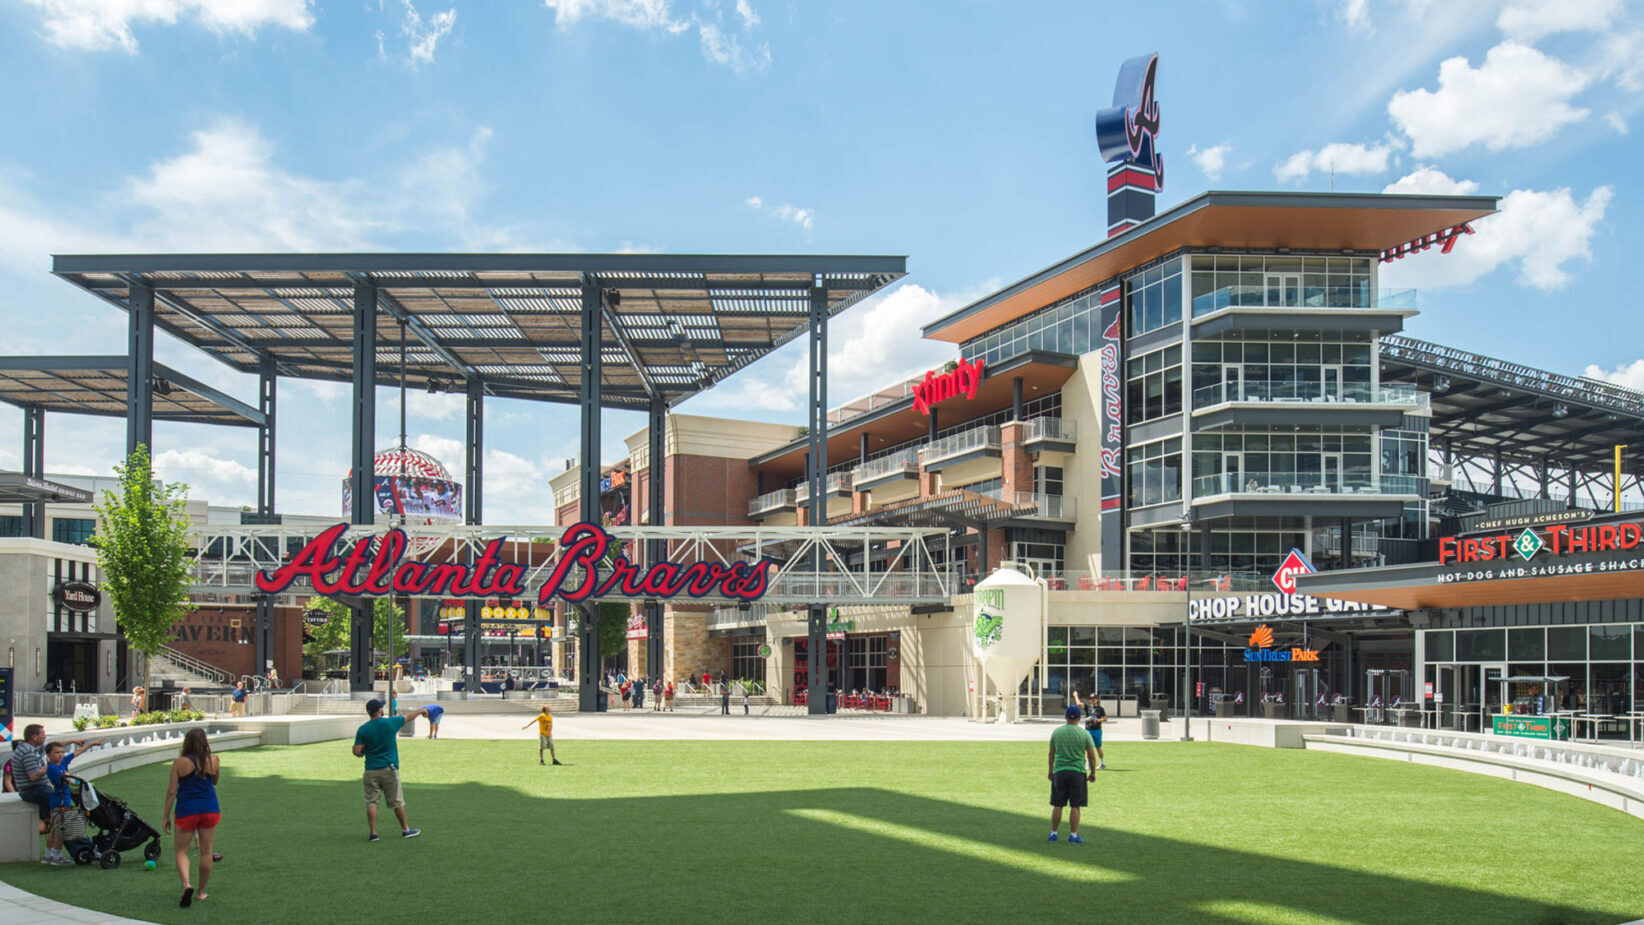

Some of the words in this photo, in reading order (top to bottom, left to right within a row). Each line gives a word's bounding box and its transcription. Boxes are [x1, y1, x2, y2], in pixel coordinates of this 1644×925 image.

[911, 357, 984, 416] xfinity
[1480, 520, 1502, 529] CHEF
[1506, 517, 1530, 526] HUGH
[1534, 511, 1586, 523] ACHESON'S
[1439, 535, 1512, 565] FIRST
[1520, 534, 1535, 553] &
[1545, 523, 1642, 555] THIRD
[255, 522, 530, 597] Atlanta
[538, 522, 772, 605] Braves
[1438, 573, 1460, 583] HOT
[1467, 570, 1493, 581] DOG
[1500, 568, 1525, 578] AND
[1531, 562, 1593, 576] SAUSAGE
[64, 590, 78, 601] Yard
[79, 591, 95, 603] House
[1188, 597, 1241, 620] CHOP
[1246, 592, 1320, 616] HOUSE
[1326, 597, 1388, 612] GA
[482, 607, 527, 619] ROXY
